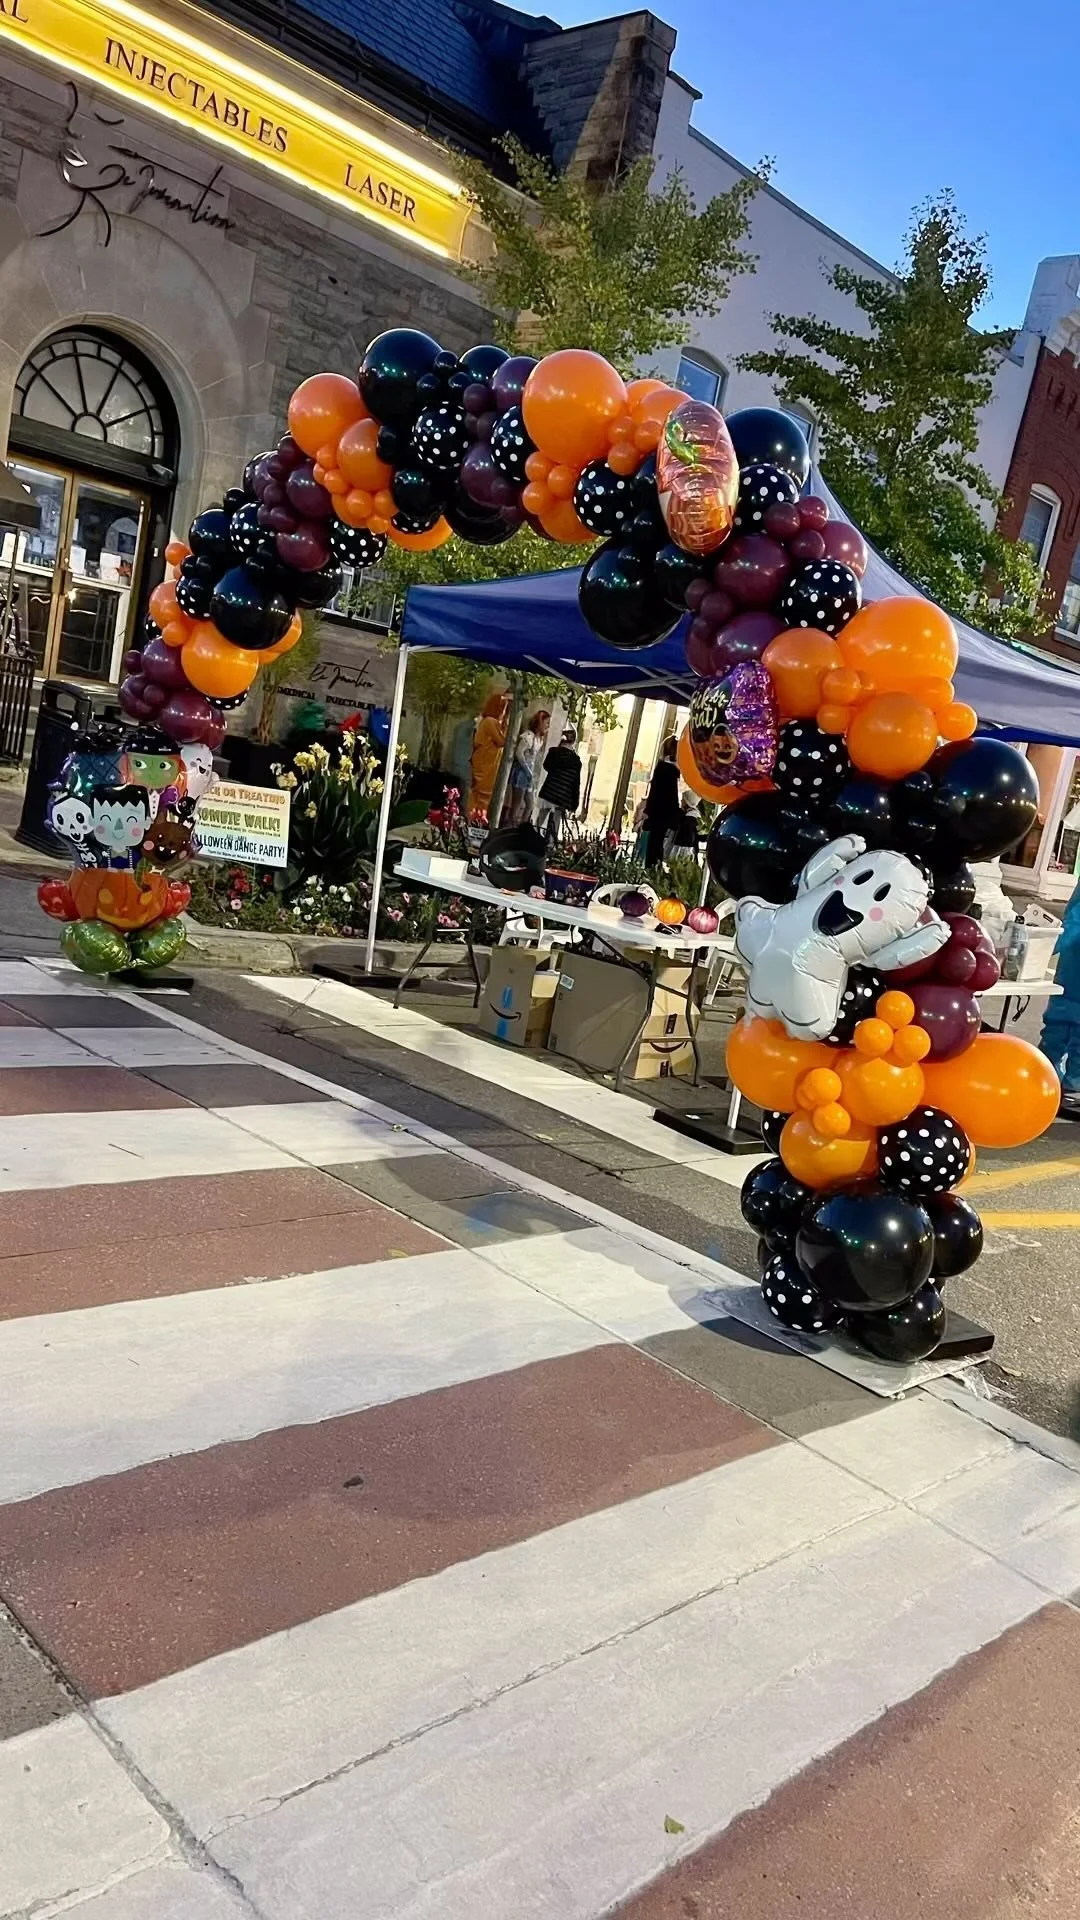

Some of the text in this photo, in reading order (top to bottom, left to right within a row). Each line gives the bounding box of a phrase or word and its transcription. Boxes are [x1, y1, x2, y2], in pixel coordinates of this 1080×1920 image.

[104, 38, 289, 153] INJECTABLES
[344, 164, 418, 222] LASER
[326, 695, 375, 710] INJECTABLE
[223, 788, 236, 798] OR
[239, 789, 286, 805] TREATING
[244, 813, 281, 832] WALK!
[199, 834, 233, 851] LLOWEEN
[234, 839, 257, 855] DANCE
[259, 844, 285, 858] PARTY!
